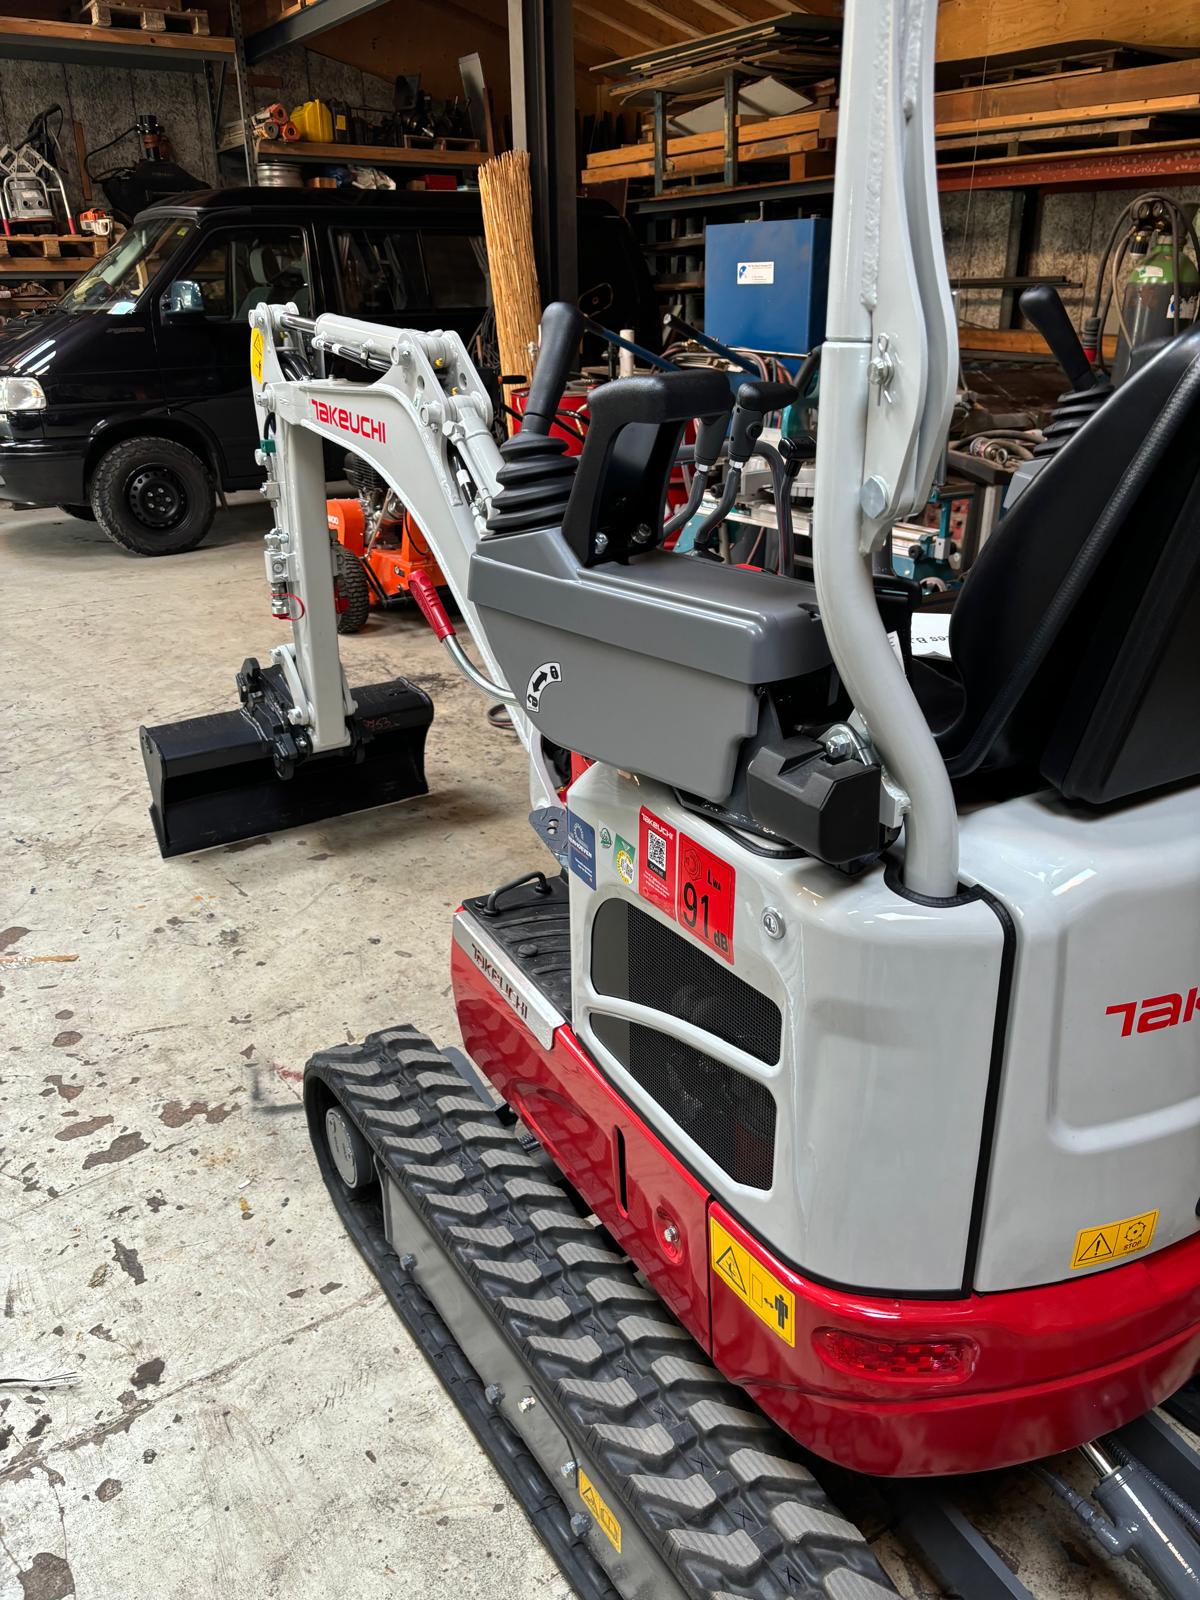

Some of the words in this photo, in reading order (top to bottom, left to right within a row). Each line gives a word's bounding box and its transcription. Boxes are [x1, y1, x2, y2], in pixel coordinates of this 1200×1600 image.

[311, 399, 386, 443] TAKEUCHI
[683, 882, 709, 939] 91
[713, 929, 729, 952] dB
[1123, 1239, 1142, 1251] STOP
